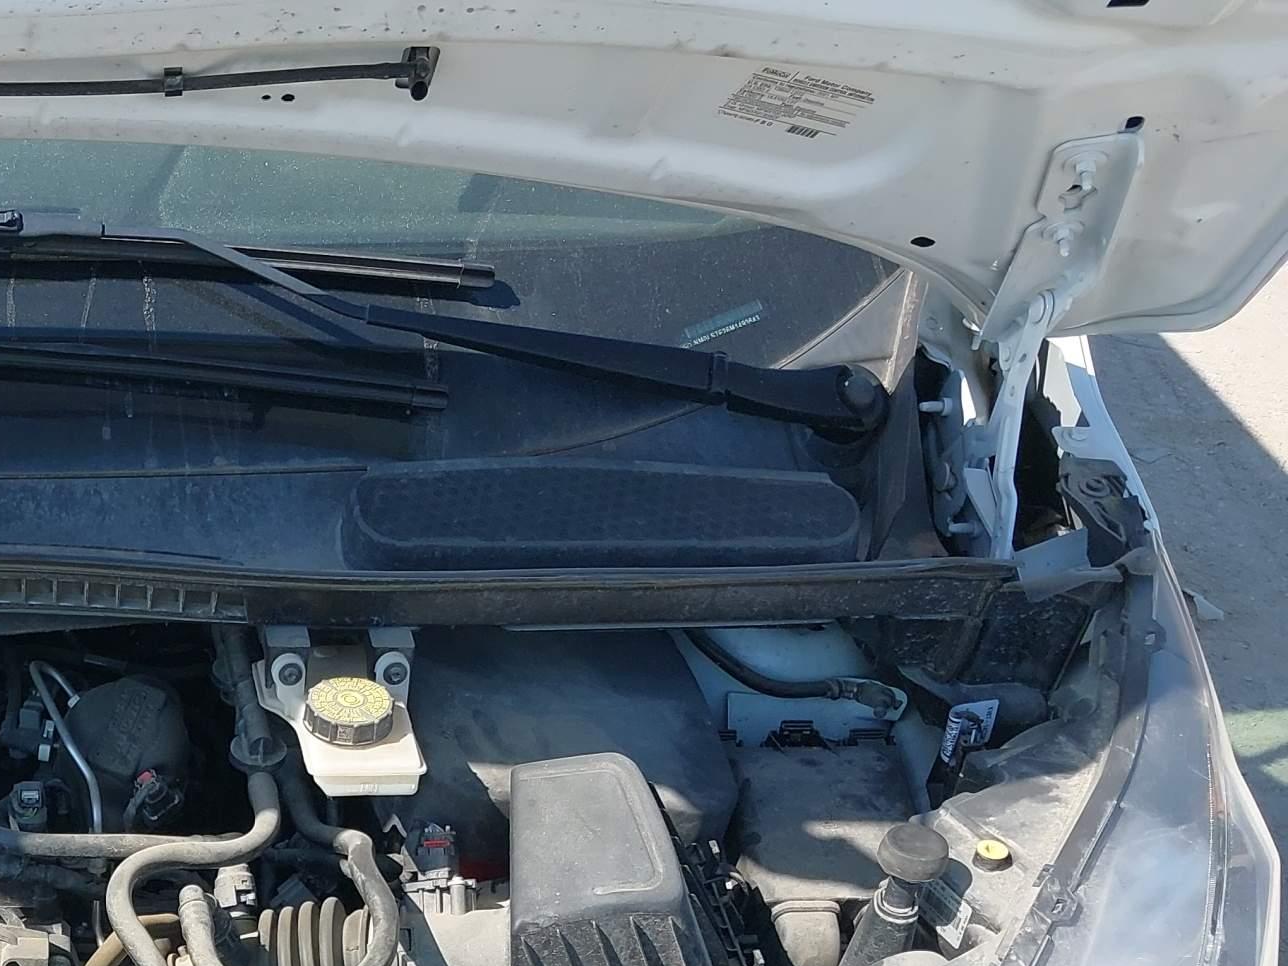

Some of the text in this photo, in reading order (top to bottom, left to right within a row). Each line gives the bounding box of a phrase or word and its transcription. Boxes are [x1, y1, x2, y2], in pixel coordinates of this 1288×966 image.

[804, 75, 873, 97] Ford Motor Company
